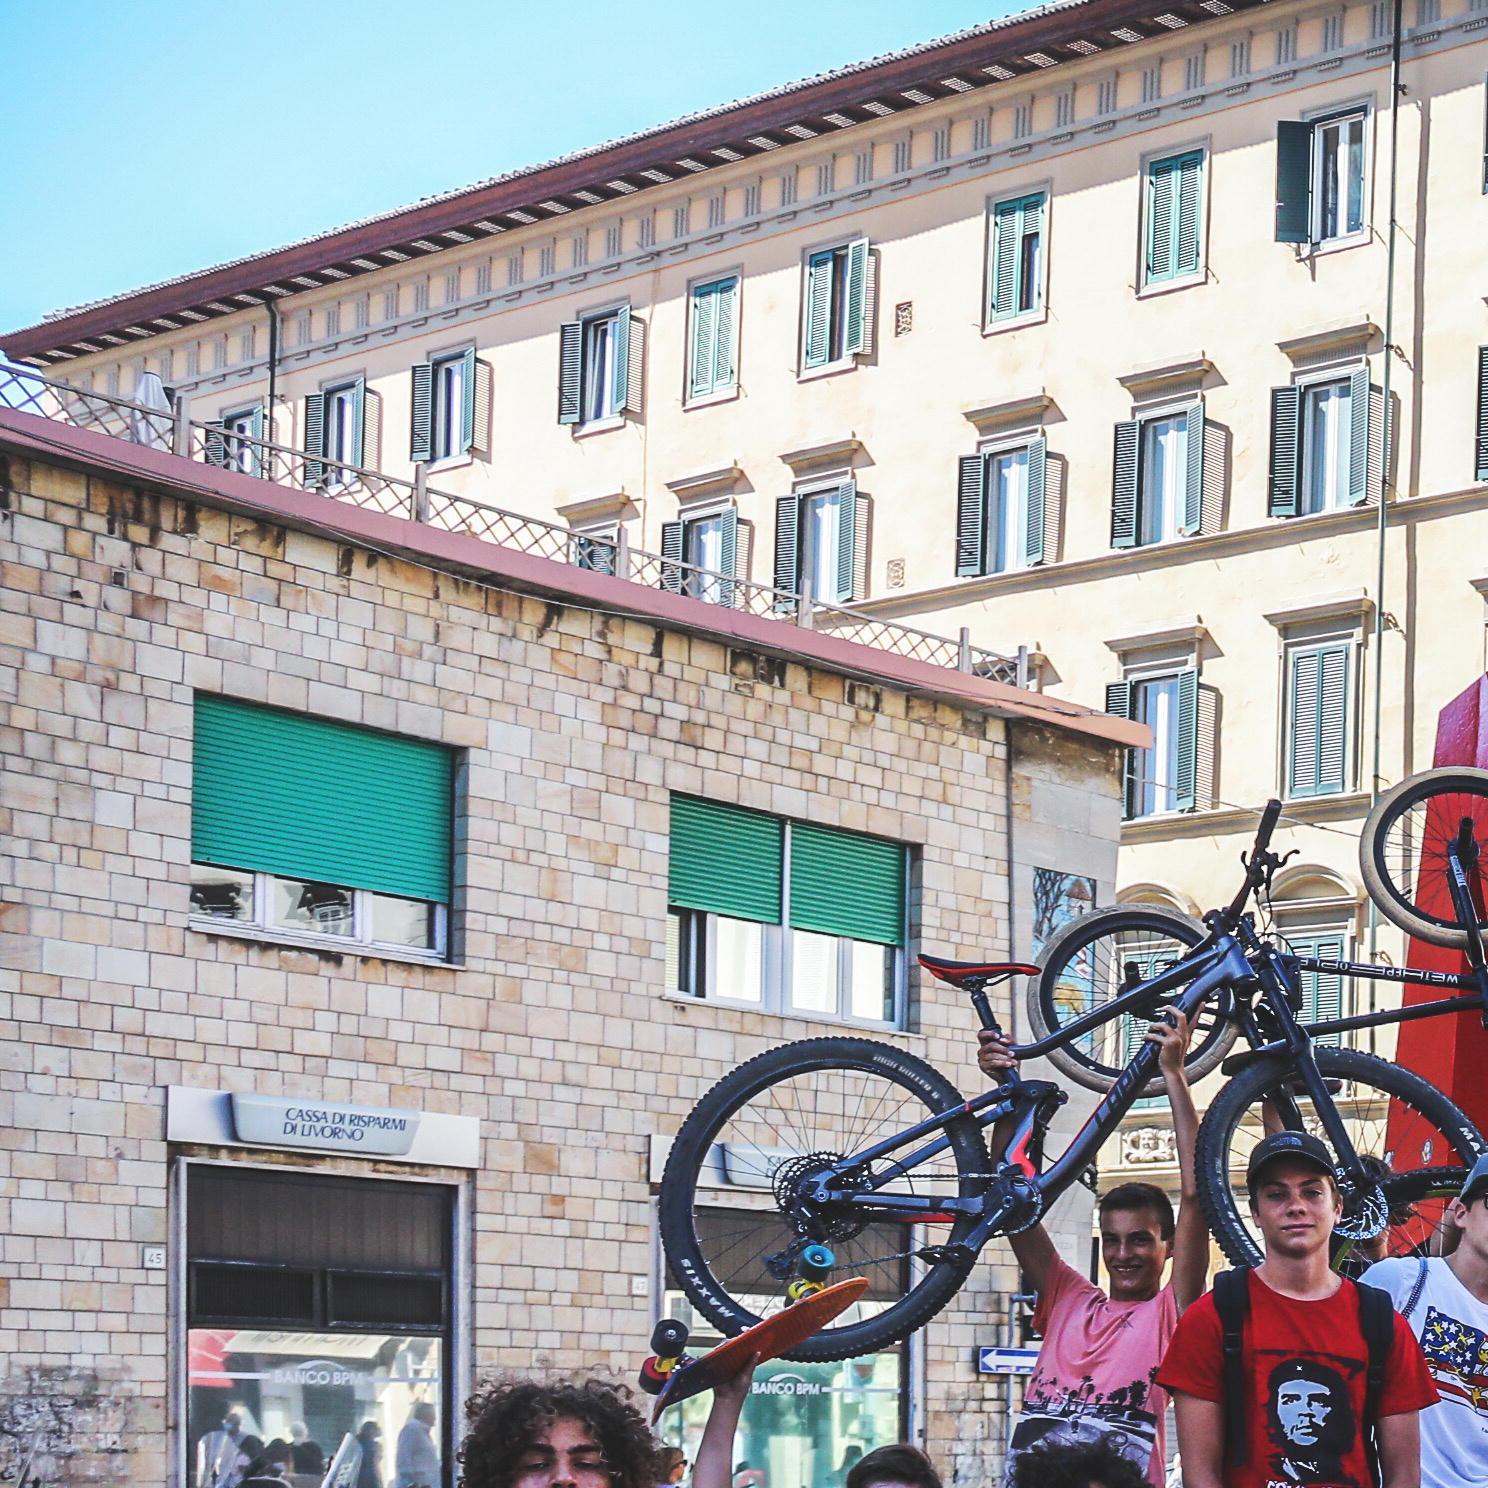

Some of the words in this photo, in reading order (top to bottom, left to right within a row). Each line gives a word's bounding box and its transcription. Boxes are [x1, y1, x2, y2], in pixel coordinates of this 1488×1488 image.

[285, 1107, 330, 1124] CASSA
[331, 1112, 347, 1126] DI
[348, 1113, 407, 1132] RISPARMI
[282, 1121, 298, 1136] DI
[300, 1123, 365, 1141] LIVORNO
[147, 1252, 162, 1265] 45
[679, 1257, 736, 1319] MAXXIS
[273, 1368, 329, 1386] BANCO
[332, 1370, 364, 1386] BPM
[751, 1381, 794, 1395] BANCO
[795, 1382, 821, 1396] BPM
